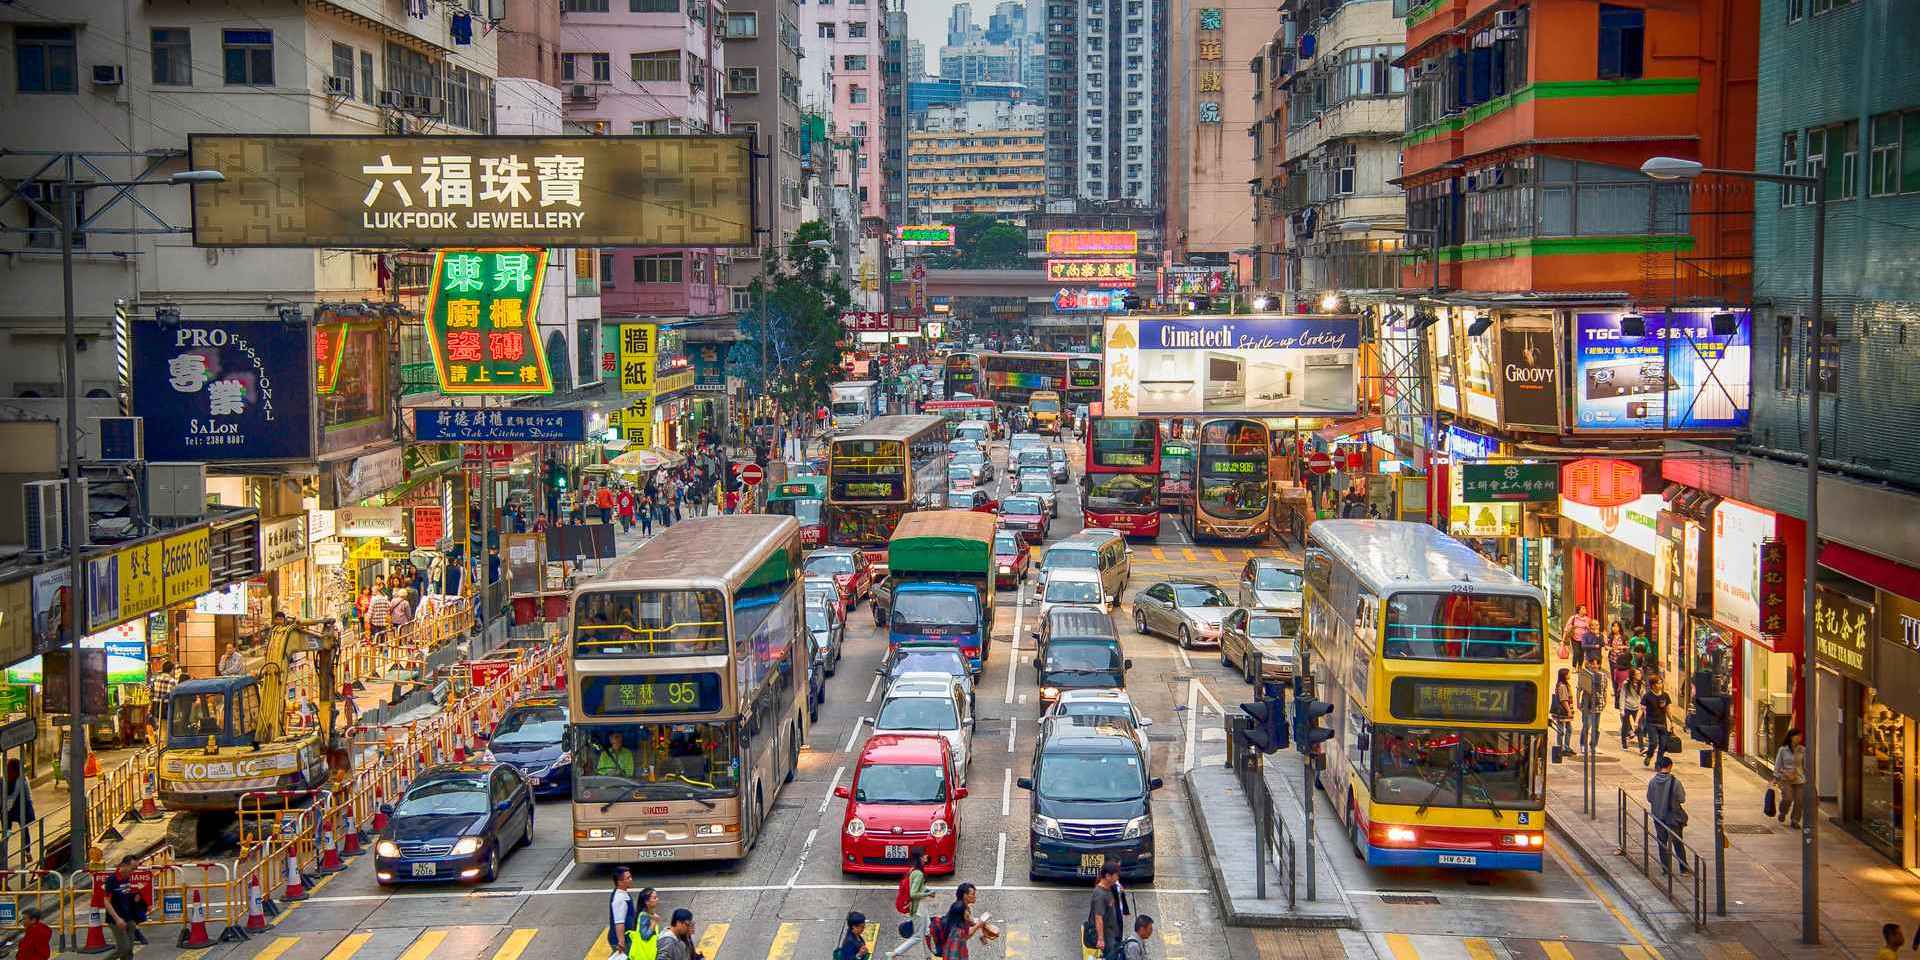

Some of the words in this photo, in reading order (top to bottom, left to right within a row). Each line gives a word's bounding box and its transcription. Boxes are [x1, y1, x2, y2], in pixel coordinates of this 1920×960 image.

[363, 155, 585, 208] 六福珠寶
[363, 212, 458, 229] LUKFOOK
[466, 212, 585, 229] JEWELLERY
[444, 254, 532, 292] 東昇
[447, 299, 522, 328] 廚櫃
[1160, 325, 1232, 348] Cimatech
[1299, 329, 1346, 351] Cooking
[1585, 328, 1620, 340] TGC
[447, 332, 523, 361] 瓷磚
[168, 353, 246, 416] 專業
[175, 328, 275, 421] PROFESSIONAL
[450, 364, 537, 383] 請上一樓
[1505, 364, 1554, 383] GROOVY
[437, 411, 503, 427] 新德廚櫃
[485, 427, 524, 438] Kitchen
[194, 537, 209, 567] 168
[668, 682, 696, 704] 95
